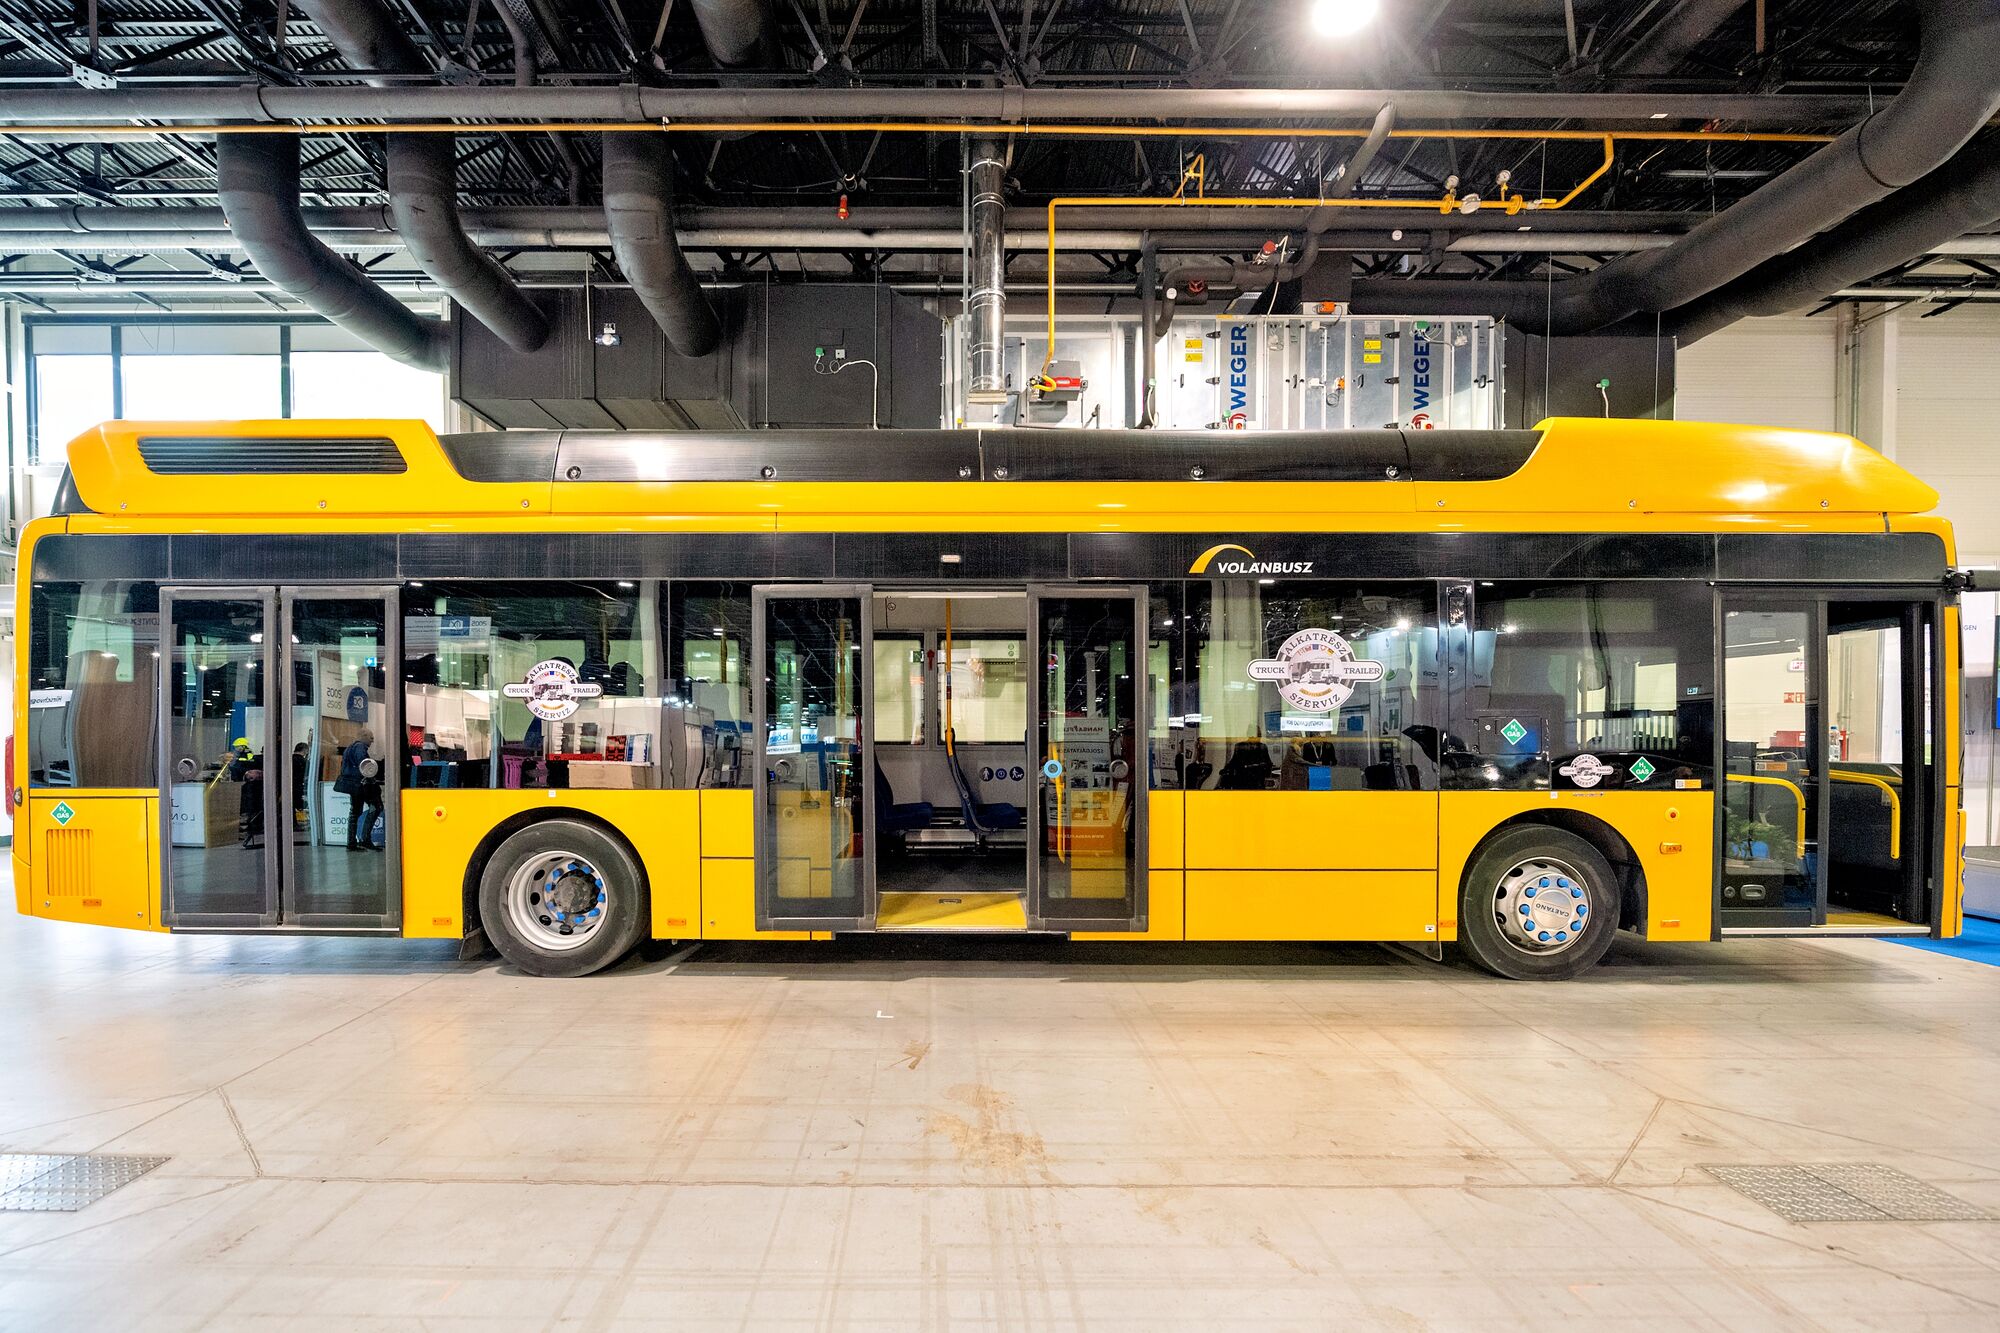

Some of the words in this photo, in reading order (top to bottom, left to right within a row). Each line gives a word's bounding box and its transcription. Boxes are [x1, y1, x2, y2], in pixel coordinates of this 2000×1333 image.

[1230, 326, 1247, 410] WEGER
[1217, 562, 1314, 574] VOLÁNBUSZ
[1255, 666, 1285, 674] TRUCK
[1343, 667, 1380, 675] TRAILER
[1289, 692, 1341, 709] SZERVIZ
[533, 706, 571, 719] SZERVIZ
[1536, 903, 1570, 918] CAETANO
